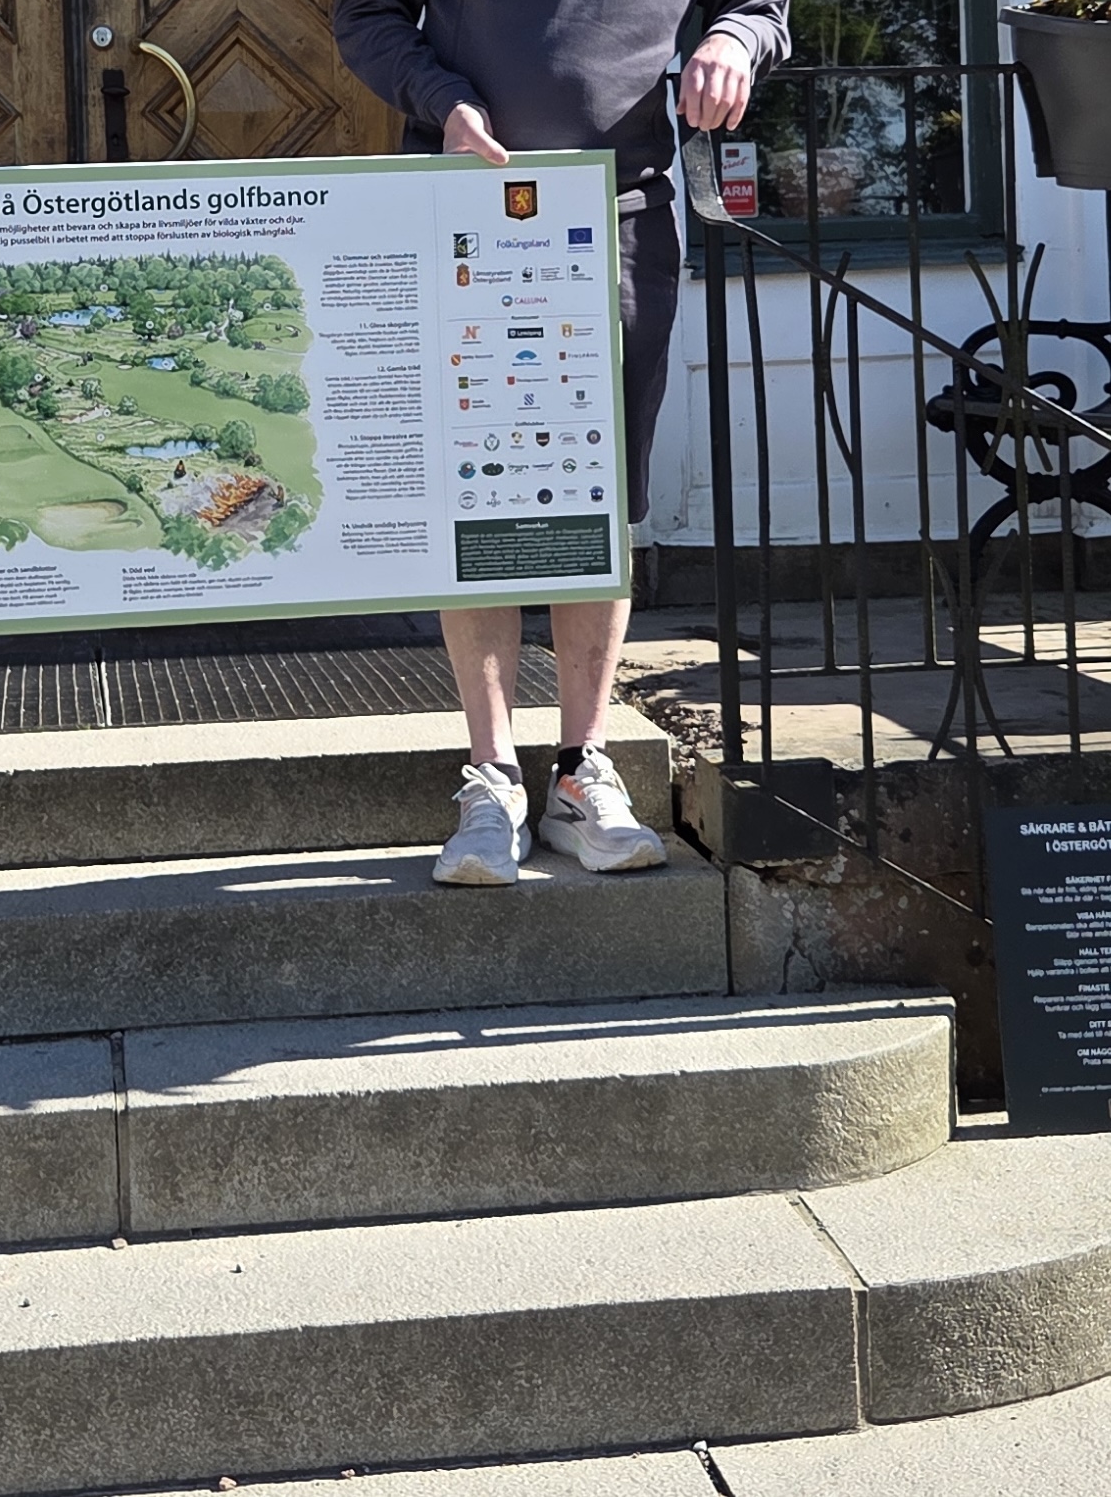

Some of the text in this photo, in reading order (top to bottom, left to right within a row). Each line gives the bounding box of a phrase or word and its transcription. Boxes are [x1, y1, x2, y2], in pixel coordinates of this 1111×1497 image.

[723, 185, 753, 197] ARM
[23, 189, 200, 218] Östergötlands
[208, 186, 329, 215] golfbanor
[0, 224, 50, 236] möjligheter
[52, 224, 65, 233] att
[66, 222, 96, 232] bevara
[98, 221, 113, 230] och
[115, 220, 141, 231] skapa
[142, 220, 157, 229] bra
[159, 219, 203, 229] livsmiljöer
[205, 218, 217, 227] för
[218, 217, 239, 227] vilda
[240, 217, 267, 226] växter
[269, 216, 285, 225] och
[286, 215, 306, 226] djur.
[10, 235, 50, 247] pusselbit
[56, 234, 89, 244] arbetet
[90, 234, 109, 243] med
[111, 233, 123, 242] att
[125, 232, 155, 243] stoppa
[157, 230, 199, 241] förslusten
[201, 231, 211, 239] av
[213, 228, 252, 240] biologisk
[253, 227, 296, 238] mångfald.
[1020, 822, 1076, 836] SÄKRARE
[1078, 822, 1087, 833] &
